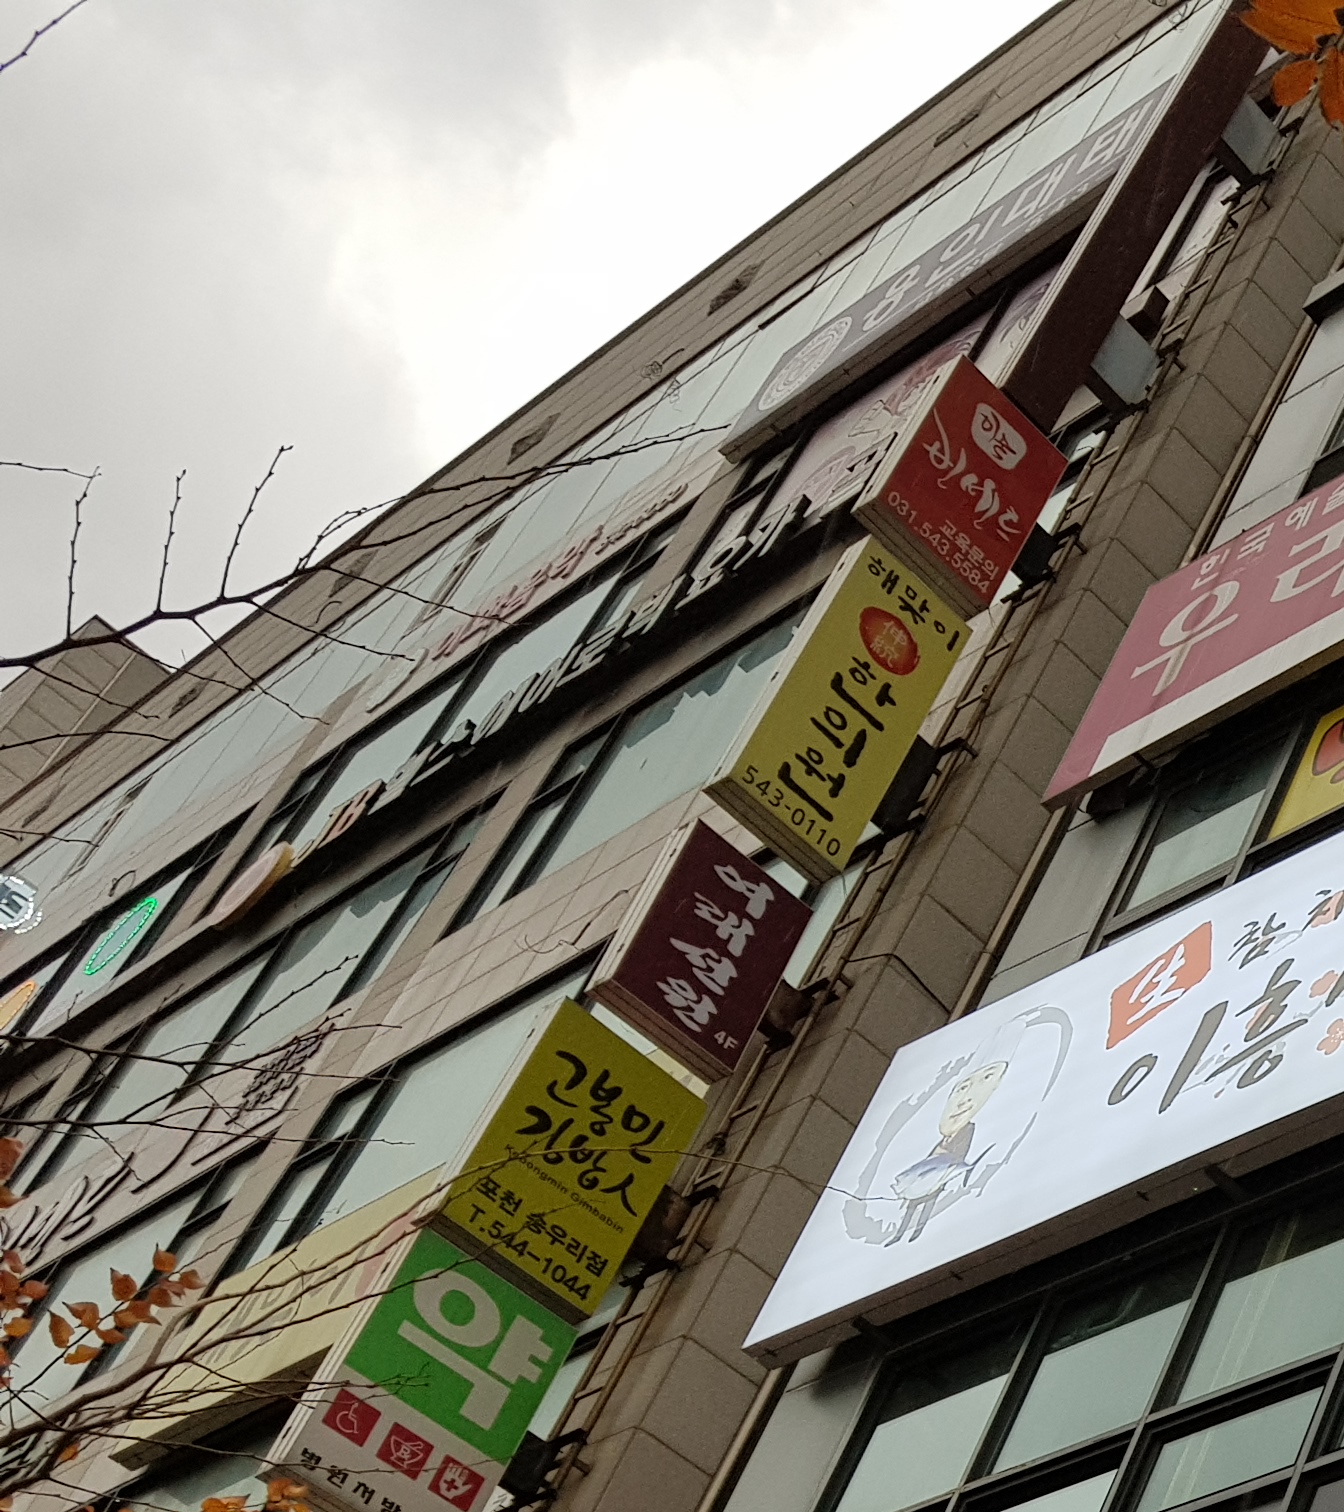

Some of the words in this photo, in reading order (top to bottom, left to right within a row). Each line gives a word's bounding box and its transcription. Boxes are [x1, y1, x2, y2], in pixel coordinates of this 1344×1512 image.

[887, 490, 991, 594] 031.543.5584
[938, 518, 1000, 580] 교육문의
[867, 555, 960, 652] 해맞이
[777, 655, 897, 822] 한의원
[741, 764, 842, 857] 543-0110
[656, 863, 775, 1033] 여래선원
[712, 1029, 739, 1051] 4F
[546, 1049, 666, 1164] 고봉민
[468, 1203, 593, 1302] T.544-1044
[475, 1177, 524, 1217] 포천
[526, 1211, 609, 1278] 송우리점
[396, 1267, 553, 1432] 약
